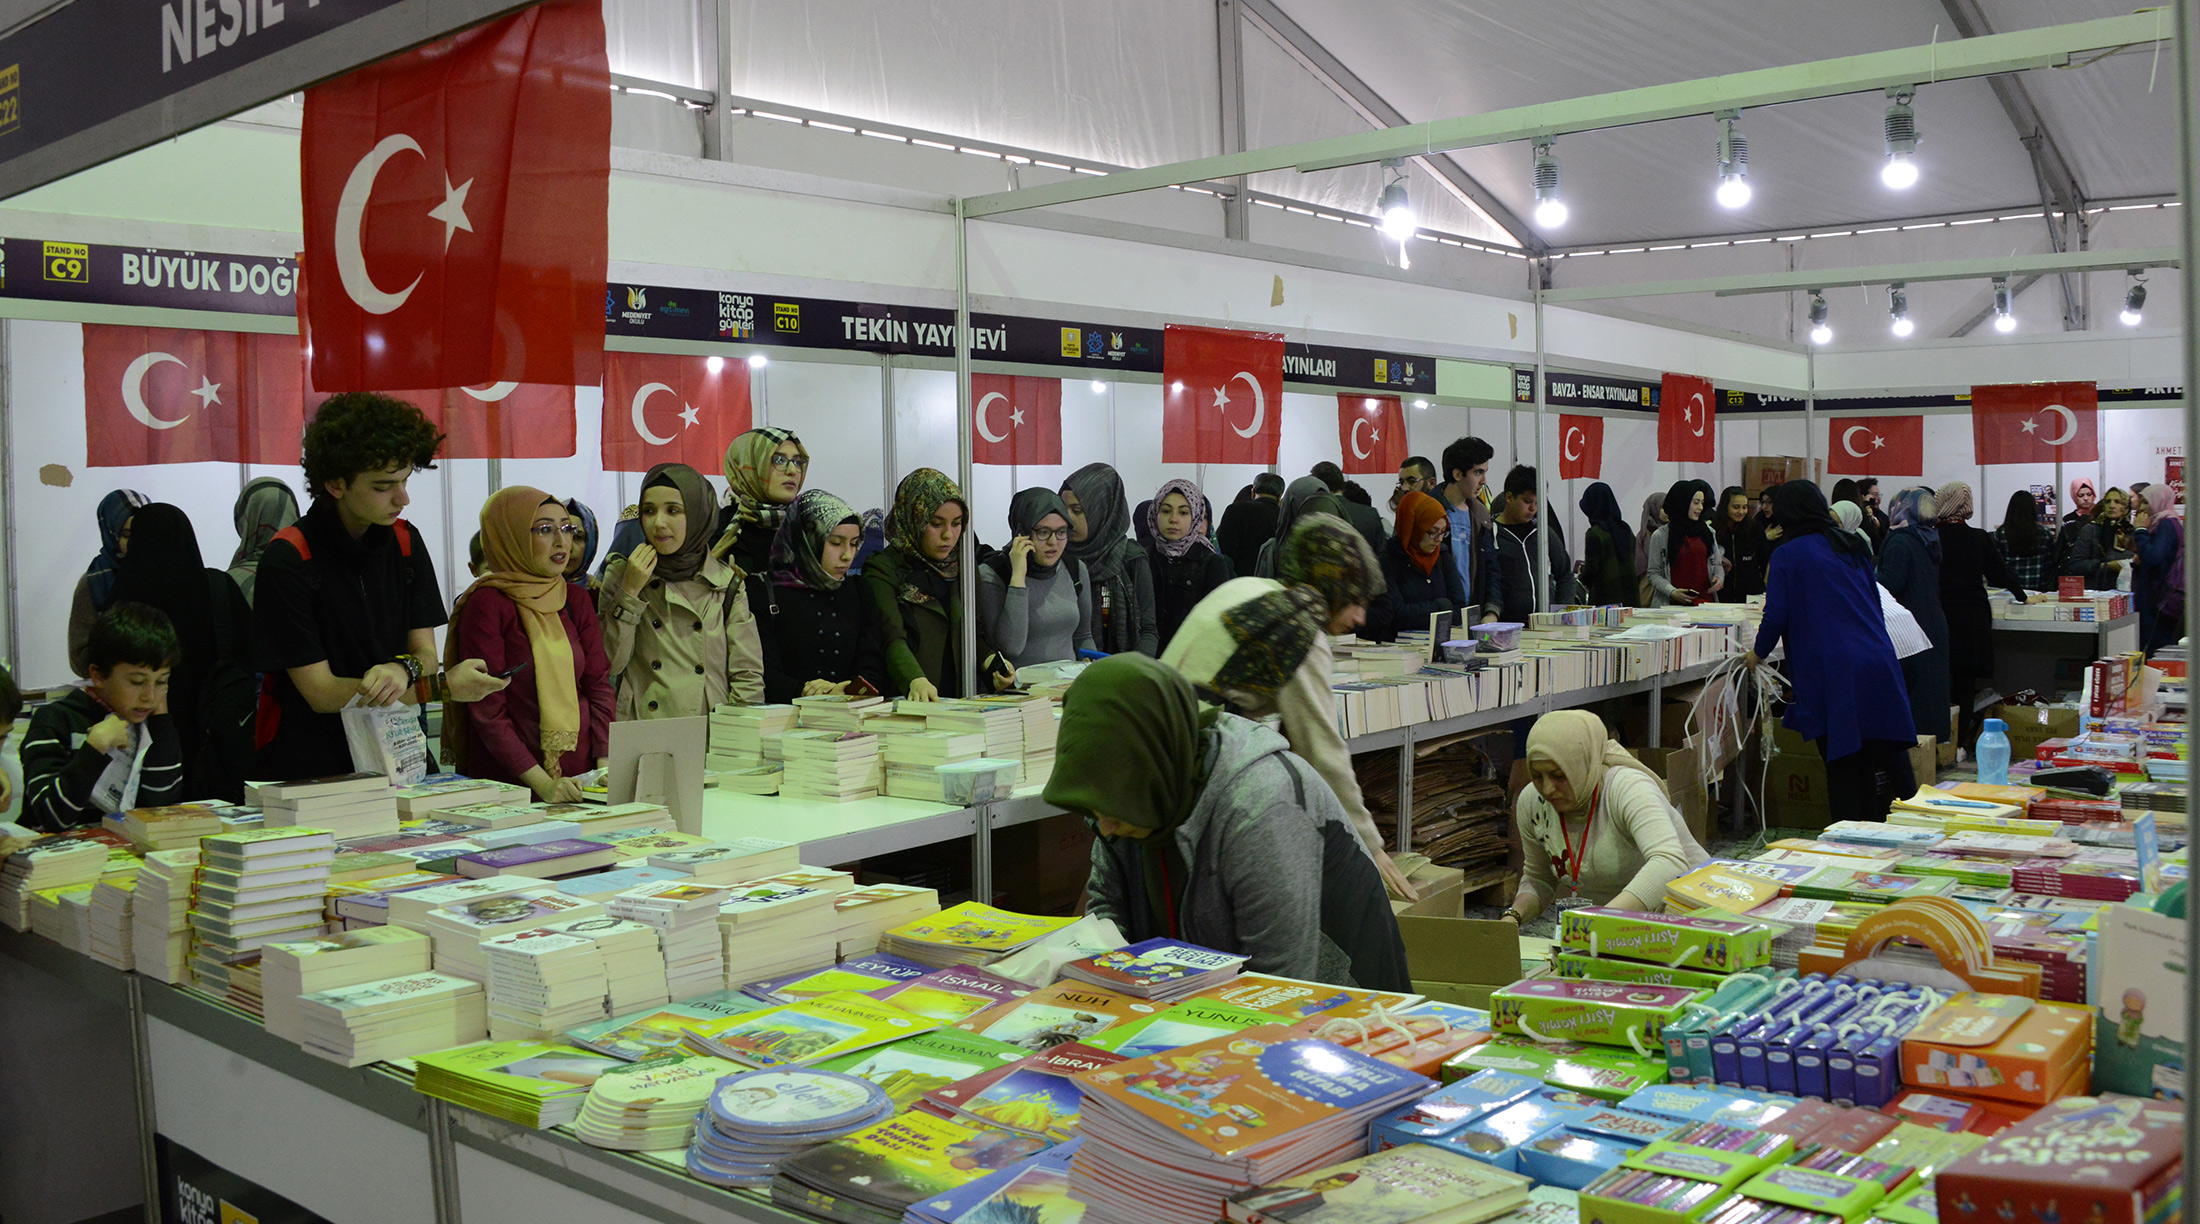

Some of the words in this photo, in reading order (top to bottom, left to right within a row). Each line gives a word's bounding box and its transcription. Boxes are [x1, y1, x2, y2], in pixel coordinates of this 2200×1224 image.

[46, 245, 71, 255] STAND
[74, 248, 86, 256] NO
[51, 258, 82, 279] C9
[122, 248, 221, 292] BÜYÜK
[719, 292, 753, 309] konya
[775, 305, 789, 313] STAND
[719, 304, 753, 320] kitap
[719, 318, 754, 332] günleri
[777, 317, 797, 330] C10
[841, 312, 908, 344] TEKİN
[912, 322, 1006, 352] YAYIEVİ
[1282, 355, 1337, 378] AYINLARI
[1552, 382, 1577, 399] RAVZA
[1582, 384, 1605, 401] ENSAR
[1605, 387, 1639, 403] YAYINLARI
[1728, 397, 1743, 405] C13
[2155, 446, 2183, 455] AHMET
[855, 961, 922, 978] EYYÜP
[938, 974, 1006, 994] İSMAİL
[1056, 992, 1111, 1007] NUH
[690, 1001, 750, 1016] DAVU
[807, 1001, 888, 1023] MUHAMMED
[1186, 1009, 1264, 1026] YUNUS
[908, 1037, 1000, 1060] SÜLEYMAN
[1289, 1069, 1354, 1099] KİTABI
[177, 1175, 215, 1215] konya
